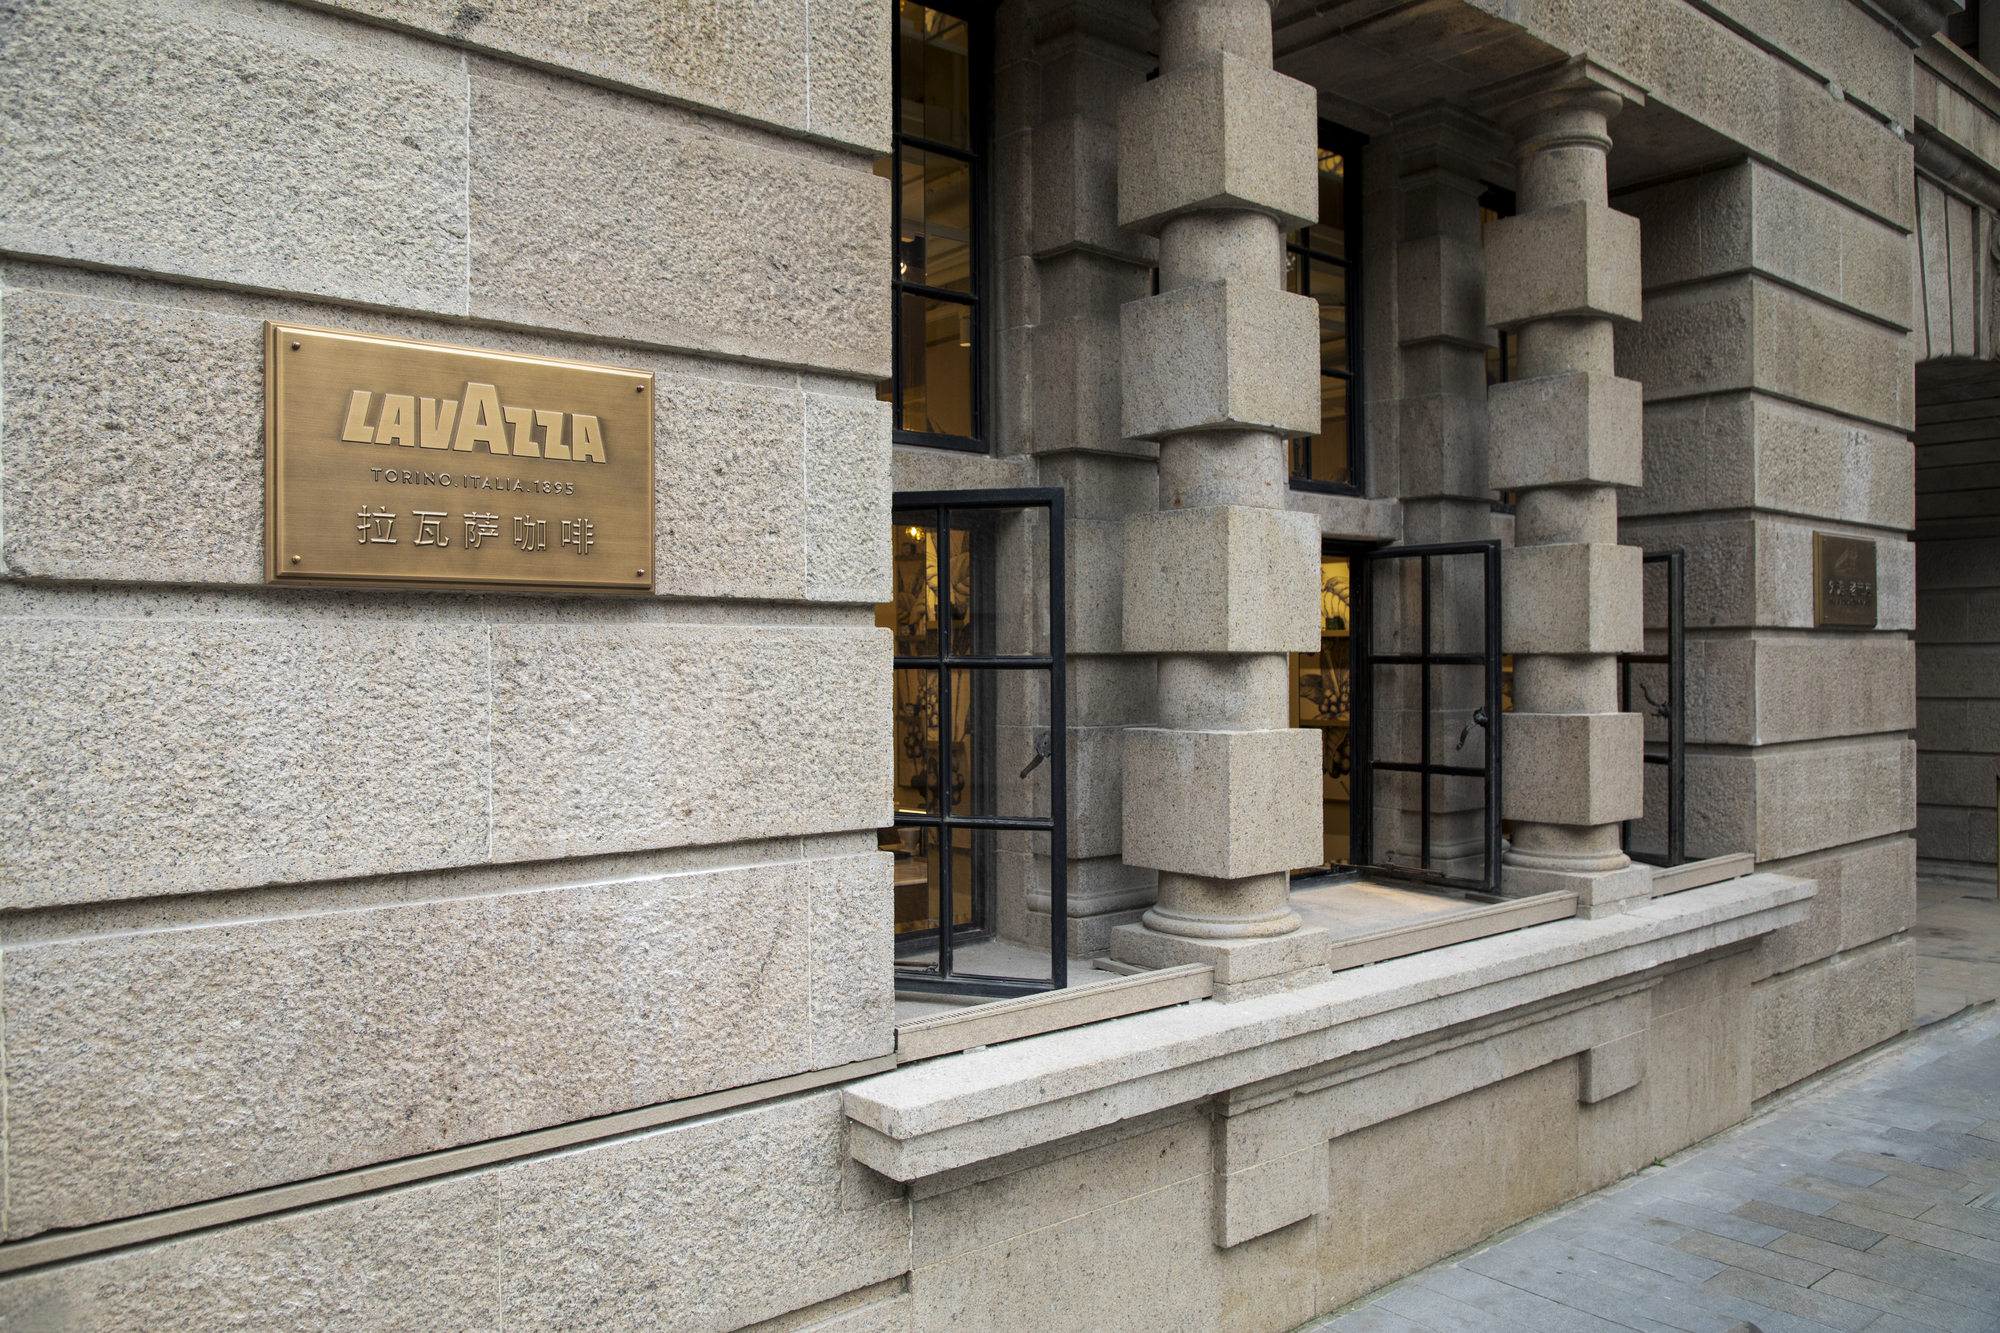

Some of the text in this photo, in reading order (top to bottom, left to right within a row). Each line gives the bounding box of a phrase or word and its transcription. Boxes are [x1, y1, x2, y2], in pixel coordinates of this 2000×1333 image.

[341, 382, 606, 463] LAVAZZA
[356, 505, 594, 555] 拉瓦萨咖啡
